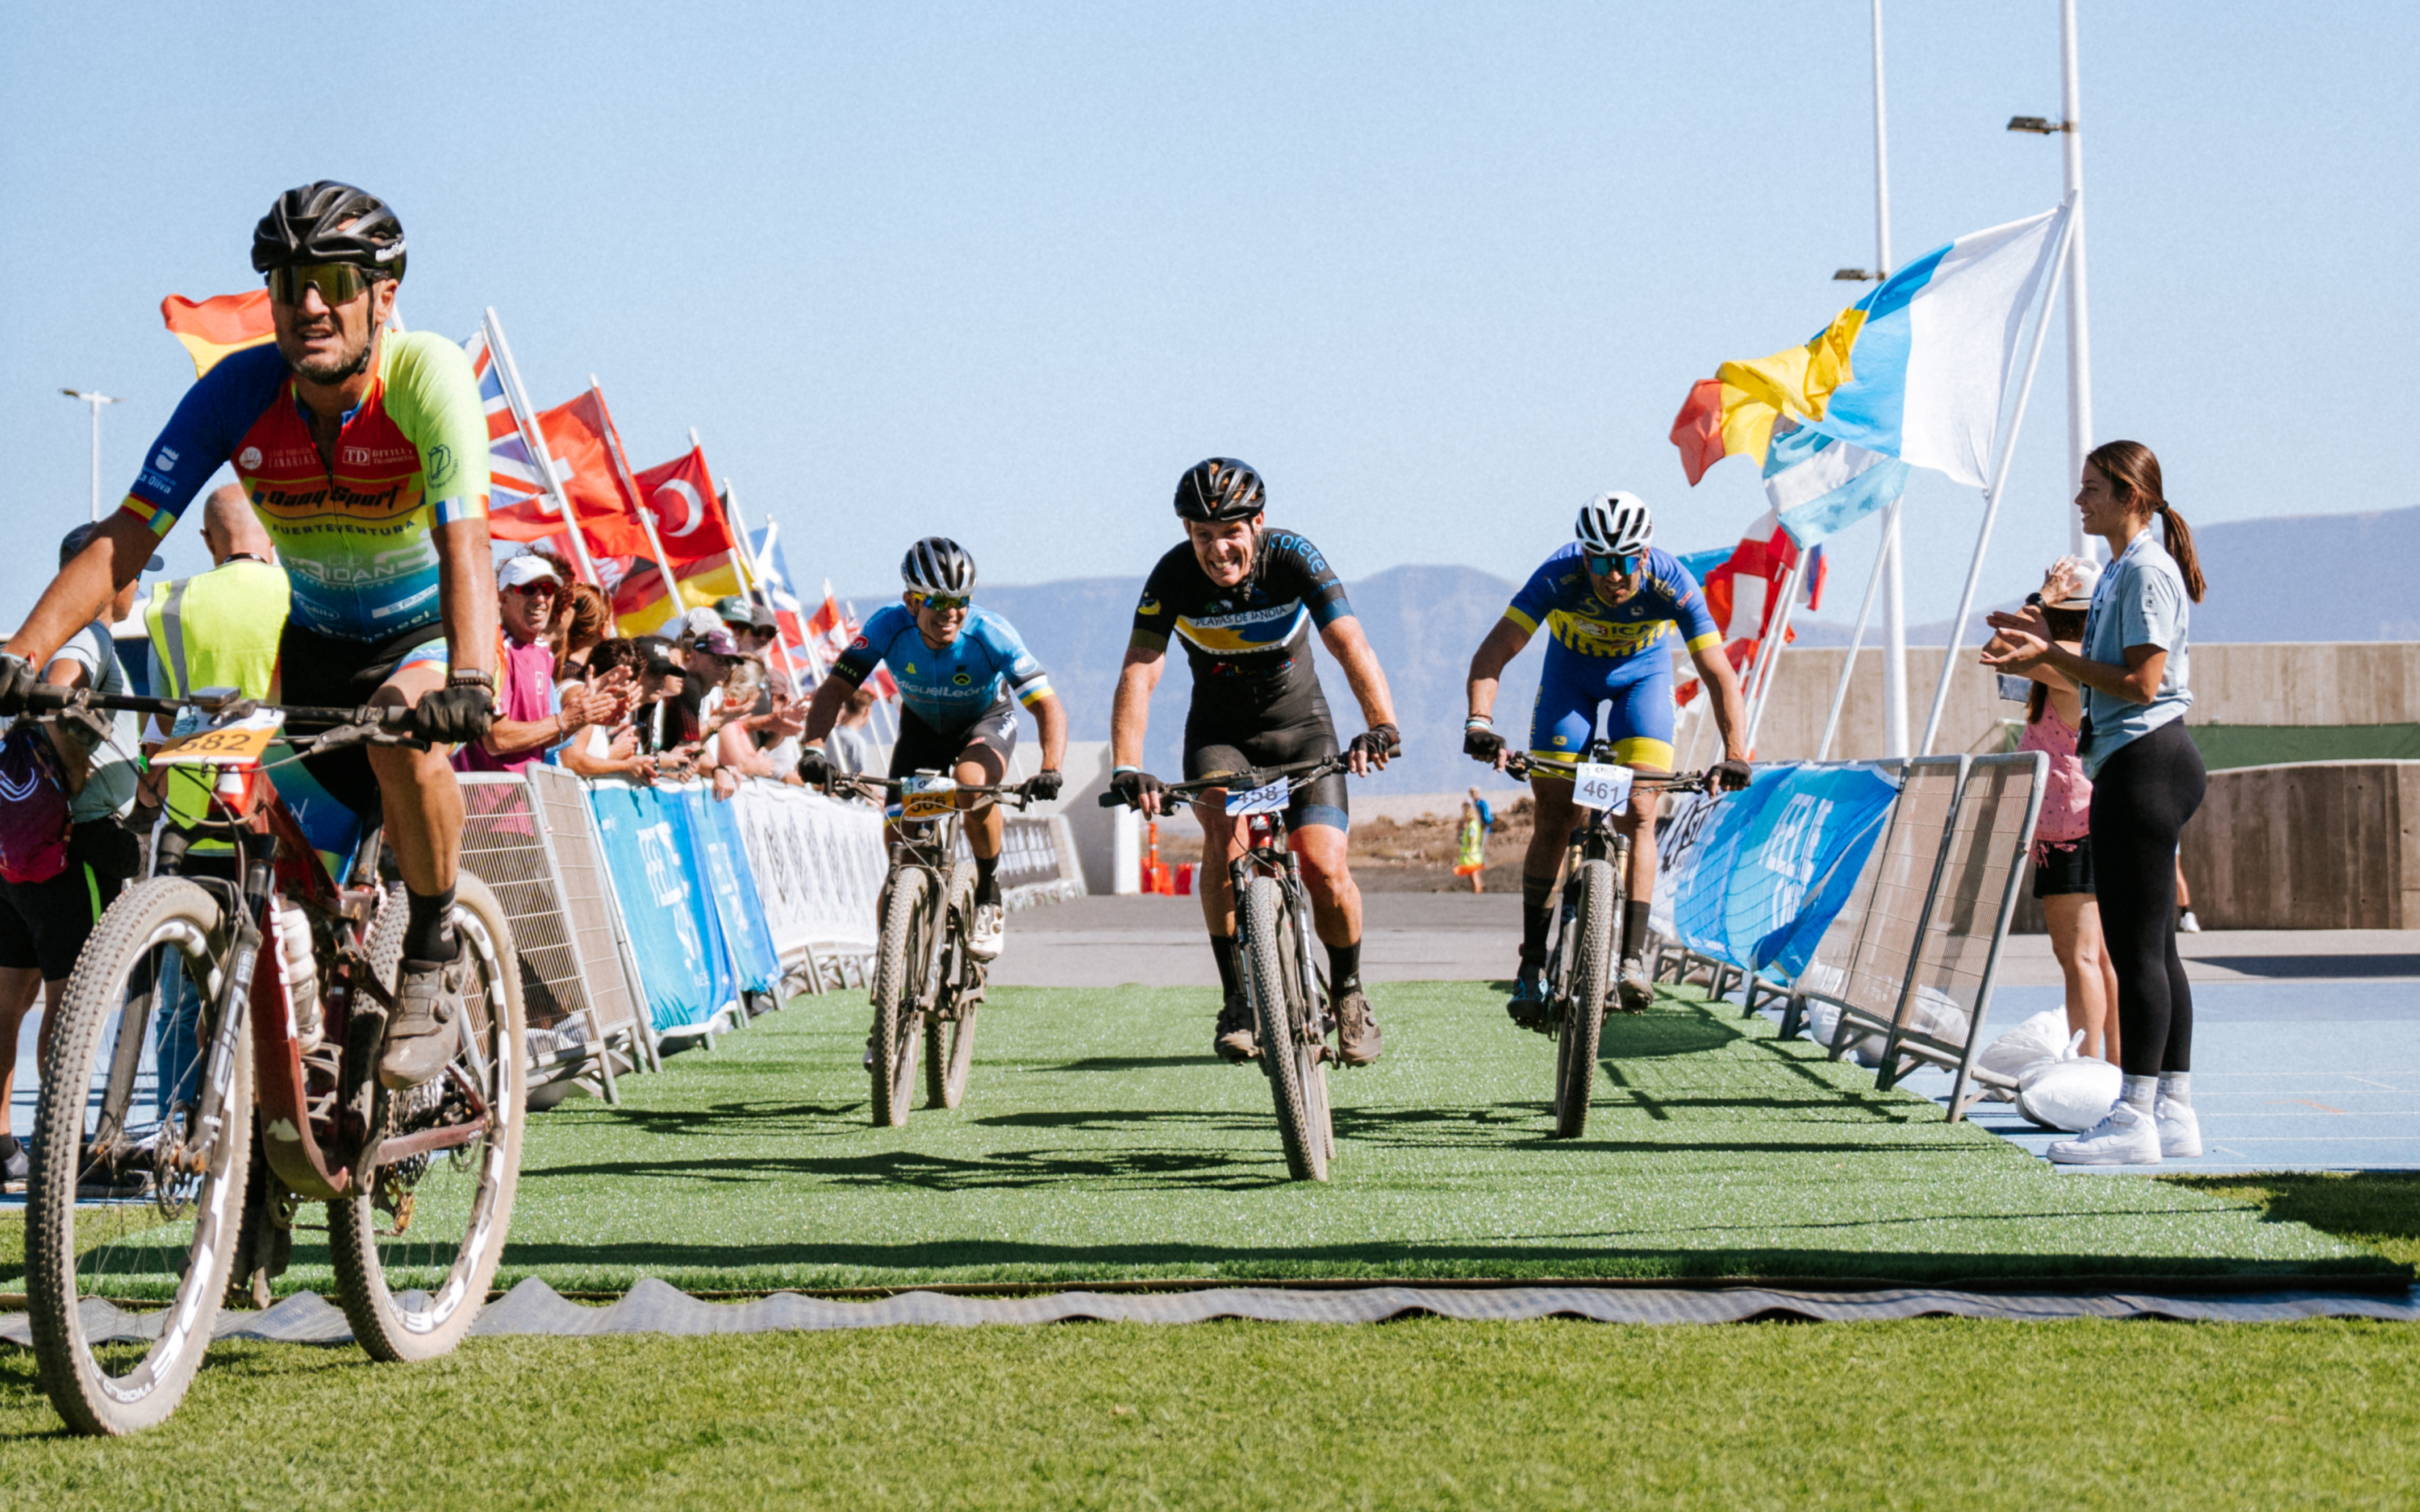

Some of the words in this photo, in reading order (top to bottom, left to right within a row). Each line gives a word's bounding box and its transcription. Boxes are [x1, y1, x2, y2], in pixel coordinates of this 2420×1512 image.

[345, 448, 369, 463] TD
[148, 475, 172, 494] Oliva
[329, 485, 403, 511] Sport
[272, 519, 415, 536] FUERTEVENTURA
[1270, 533, 1326, 574] cofete
[389, 585, 436, 612] SPAR
[1195, 614, 1233, 627] PLAYAS
[1234, 613, 1249, 623] DE
[175, 733, 251, 752] 582
[1235, 785, 1278, 804] 458
[1583, 780, 1619, 803] 461
[910, 795, 946, 813] 566
[102, 1379, 154, 1402] WORLD
